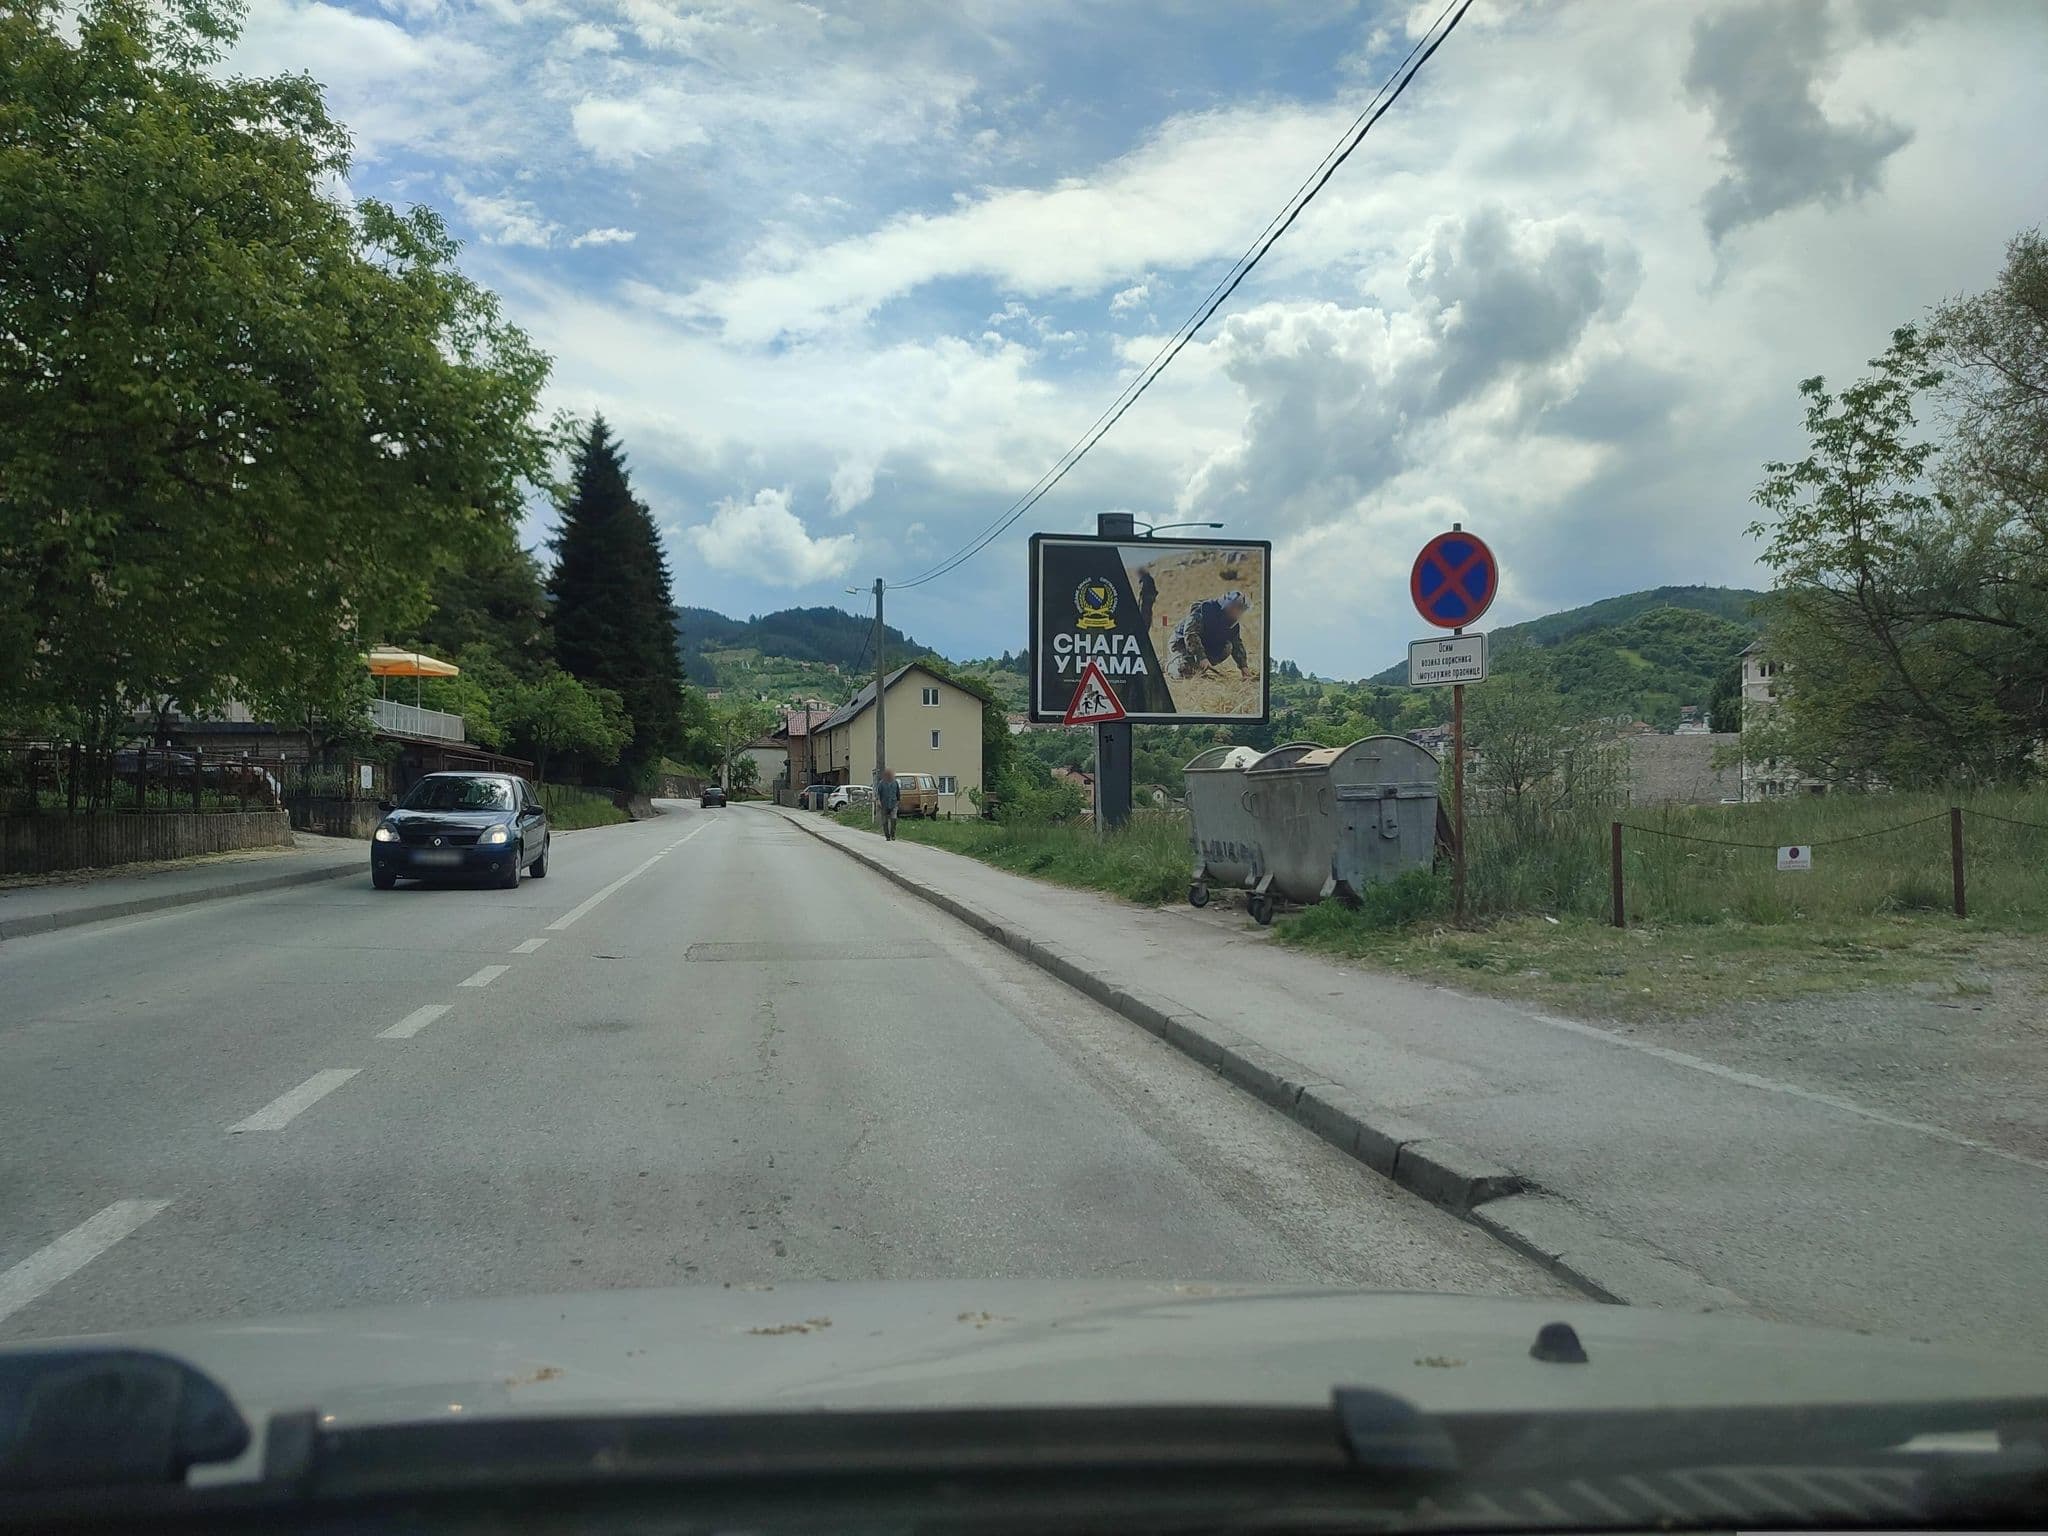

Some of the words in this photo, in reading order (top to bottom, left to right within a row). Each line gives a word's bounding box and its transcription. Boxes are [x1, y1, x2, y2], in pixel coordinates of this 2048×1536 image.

[1053, 633, 1141, 654] СНАГА
[1438, 643, 1453, 653] Осим
[1053, 655, 1071, 674] У
[1075, 655, 1148, 675] НАМА
[1416, 670, 1451, 681] моуслужне
